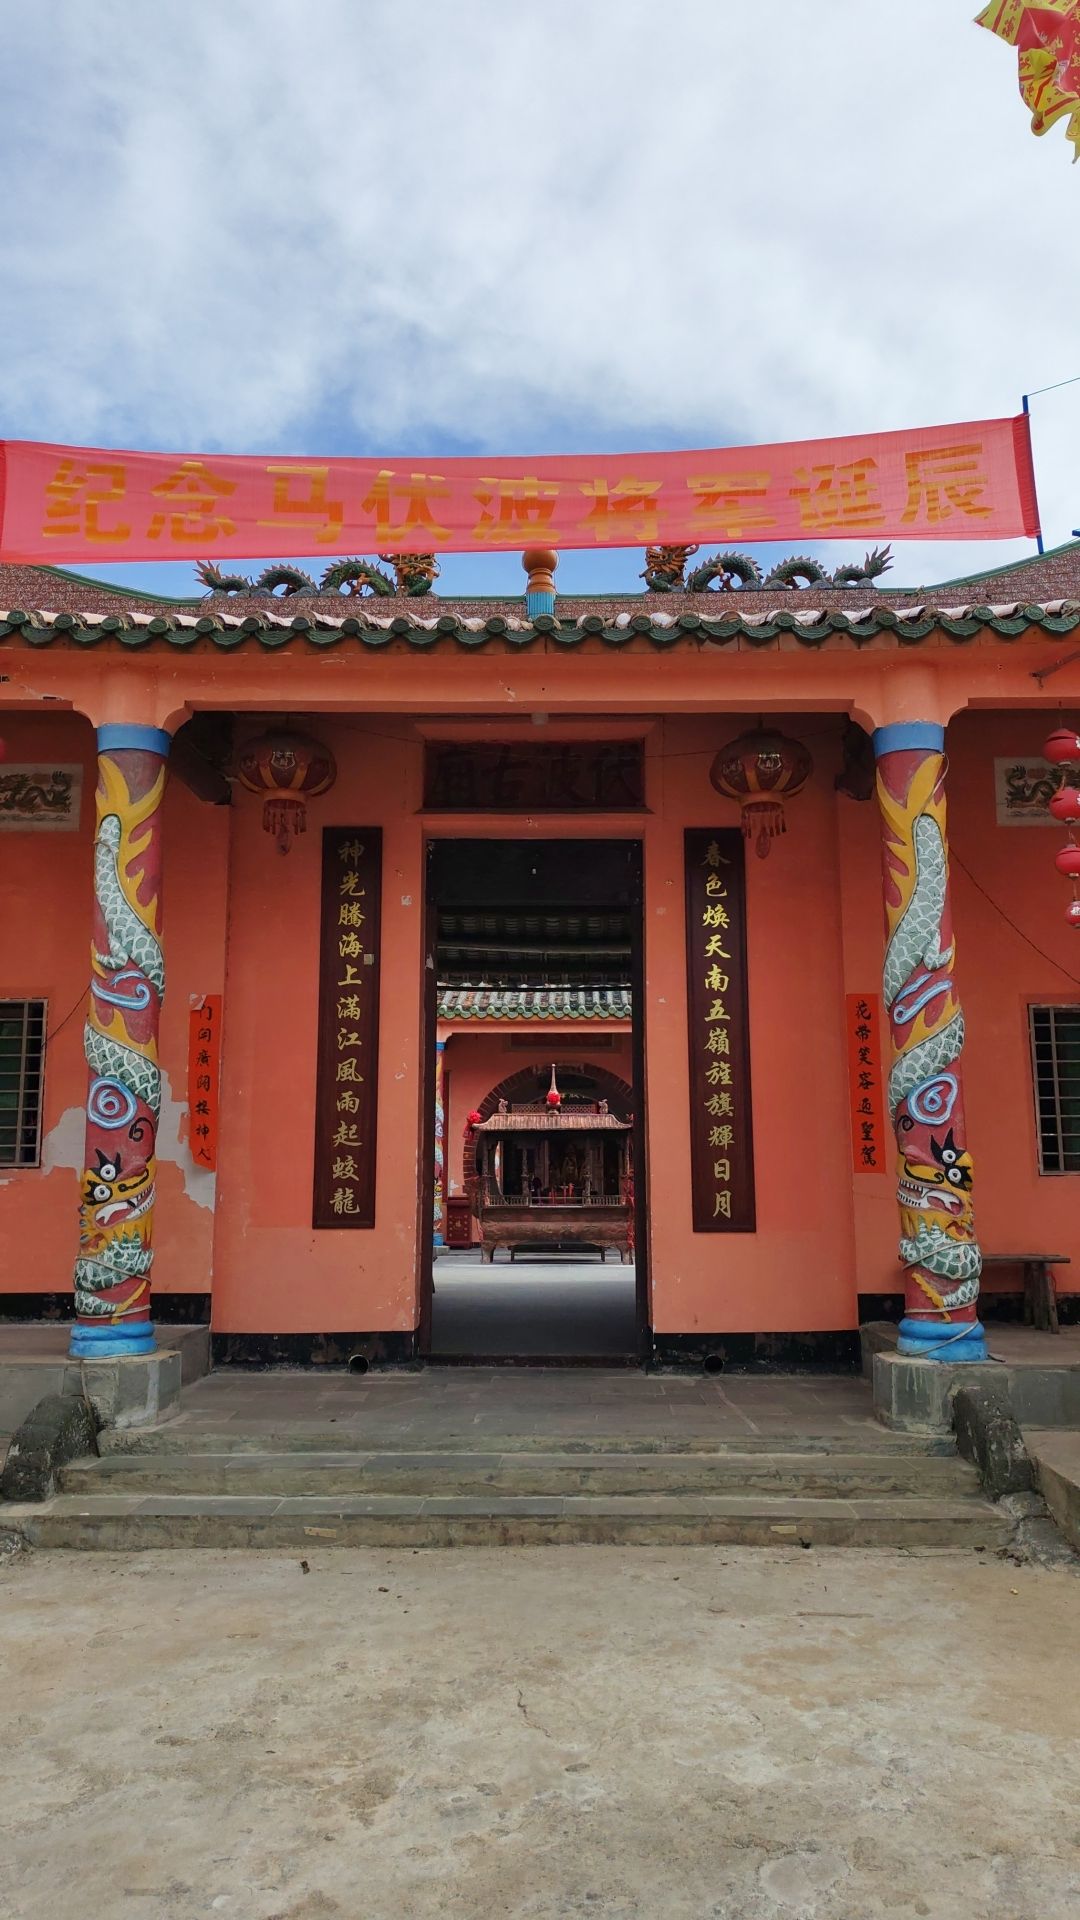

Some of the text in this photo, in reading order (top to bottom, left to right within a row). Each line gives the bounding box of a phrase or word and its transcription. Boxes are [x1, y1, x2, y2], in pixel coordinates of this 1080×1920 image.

[42, 442, 995, 544] 纪念马伏波将军诞辰
